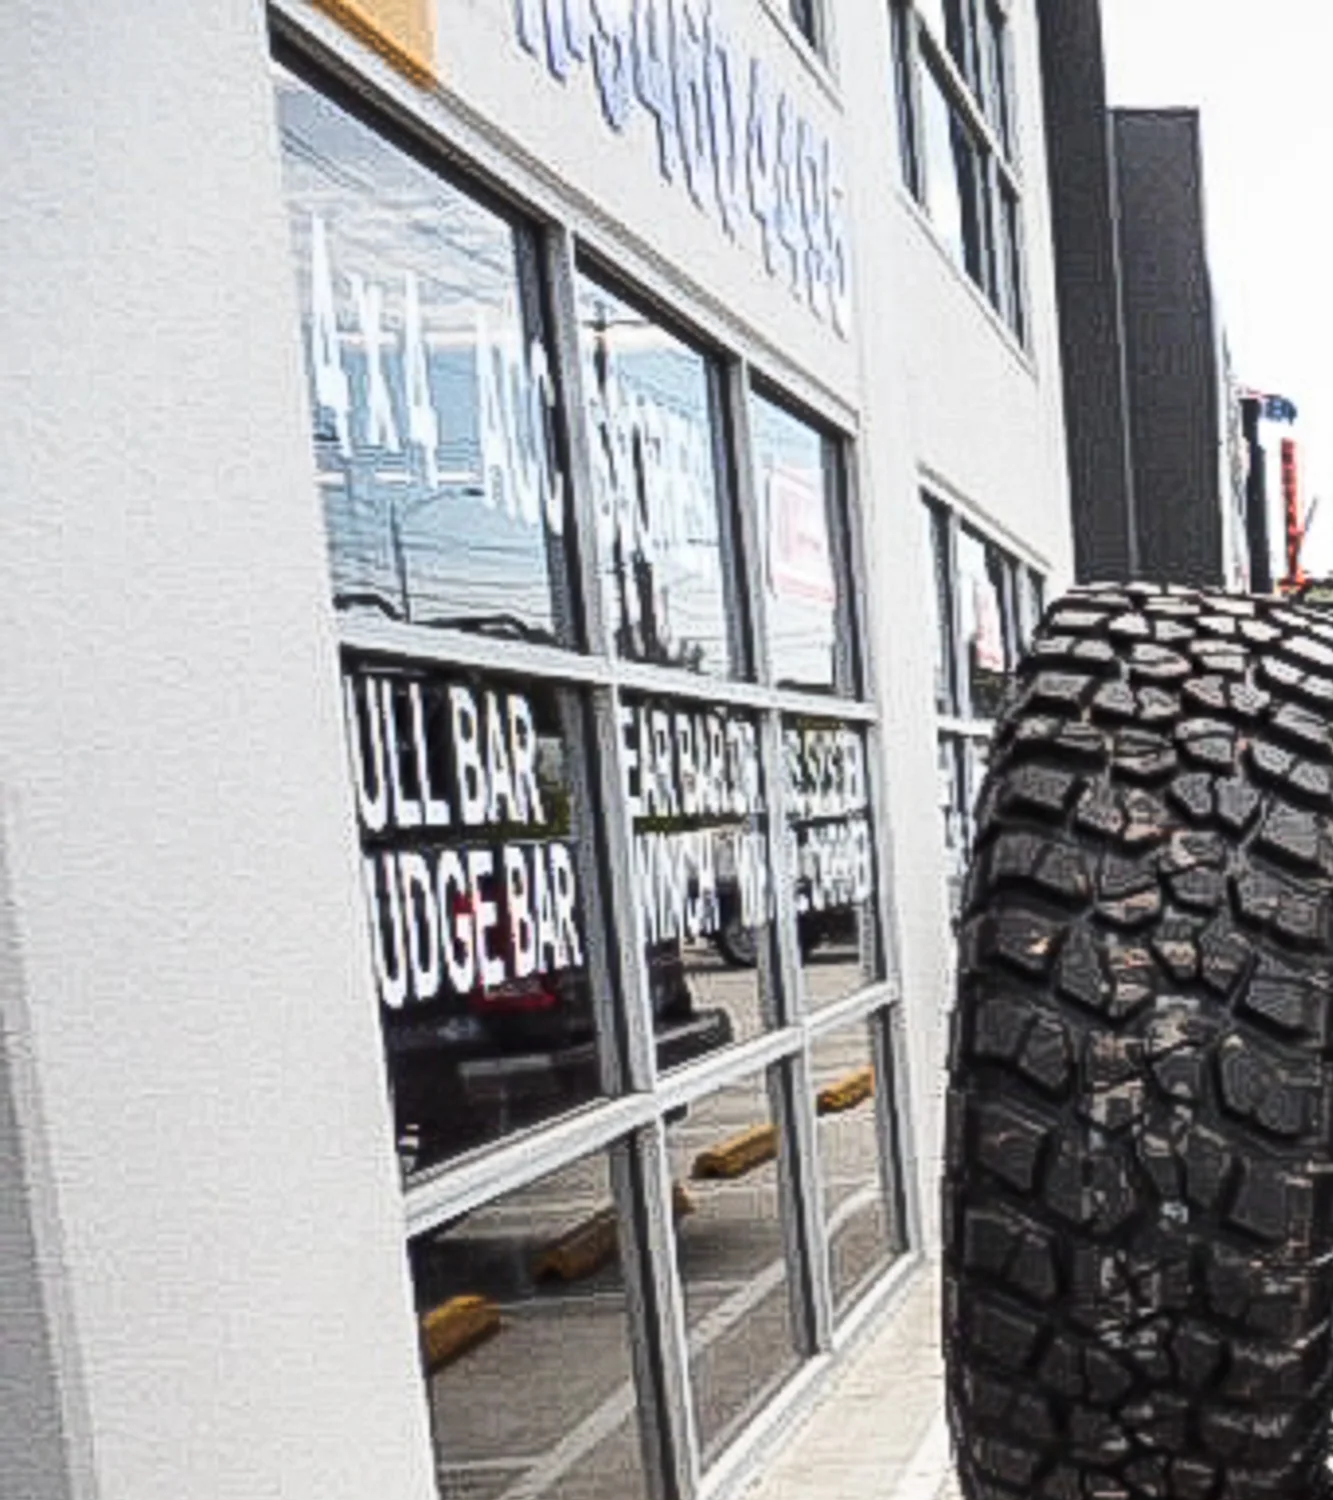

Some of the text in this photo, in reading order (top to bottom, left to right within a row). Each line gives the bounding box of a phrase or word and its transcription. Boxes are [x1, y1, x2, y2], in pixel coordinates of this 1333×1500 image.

[449, 685, 546, 826] BAR
[363, 848, 506, 1009] UDGE
[504, 843, 585, 978] BAR
